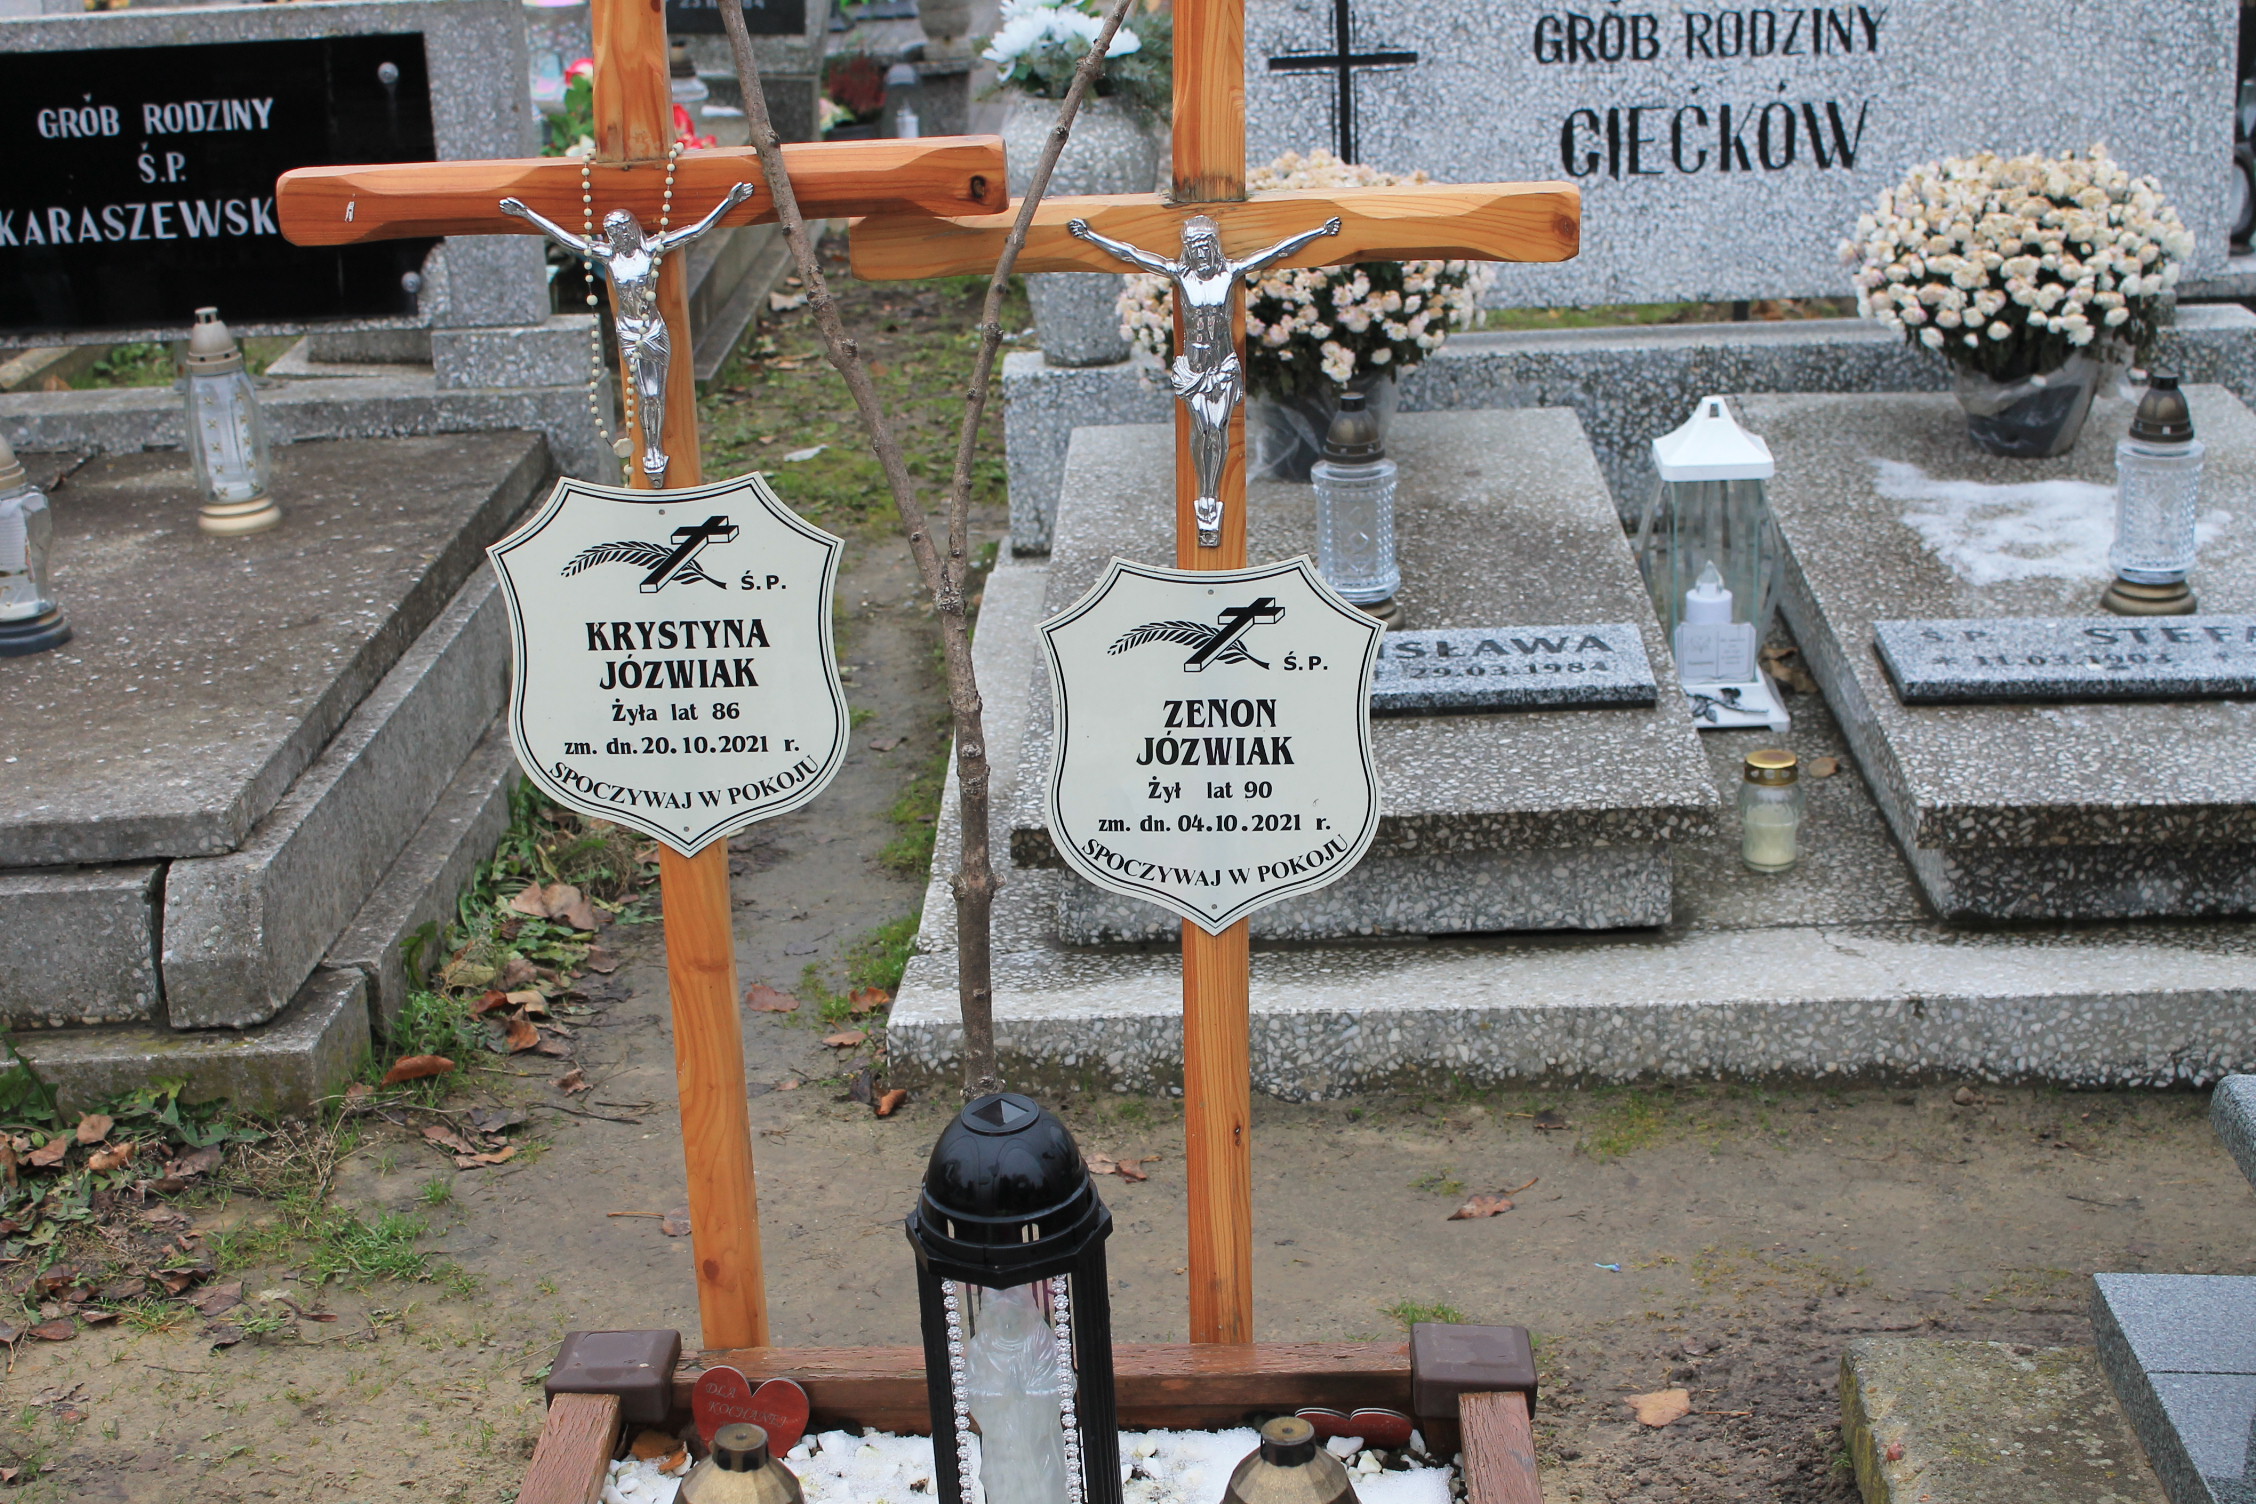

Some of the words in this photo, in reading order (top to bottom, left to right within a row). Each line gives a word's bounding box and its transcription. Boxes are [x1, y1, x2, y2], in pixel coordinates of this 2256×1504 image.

[1534, 0, 1661, 64] GRÓB
[1686, 6, 1889, 60] RODZINY
[37, 92, 121, 139] GRÓB
[143, 97, 274, 136] RODZINY
[585, 618, 771, 652] KRYSTYNA
[599, 653, 759, 690] JÓZWIAK
[611, 697, 658, 726] Żyła
[671, 703, 699, 721] lat
[712, 702, 740, 720] 86
[1162, 698, 1277, 729] ZENON
[564, 740, 598, 756] zm.
[783, 737, 800, 752] r.
[1136, 730, 1295, 766] JÓZWIAK
[549, 761, 692, 810] SPOCZYWAJ
[698, 789, 721, 808] W
[728, 754, 820, 805] POKOJU
[1148, 776, 1181, 804] Żył
[1207, 781, 1233, 799] lat
[1244, 780, 1273, 799] 90
[1098, 818, 1131, 833] zm.
[1315, 817, 1331, 831] r.
[1080, 838, 1222, 888] SPOCZYWAJ
[1228, 868, 1250, 885] W
[1257, 834, 1349, 883] POKOJU
[705, 1382, 737, 1399] DLA
